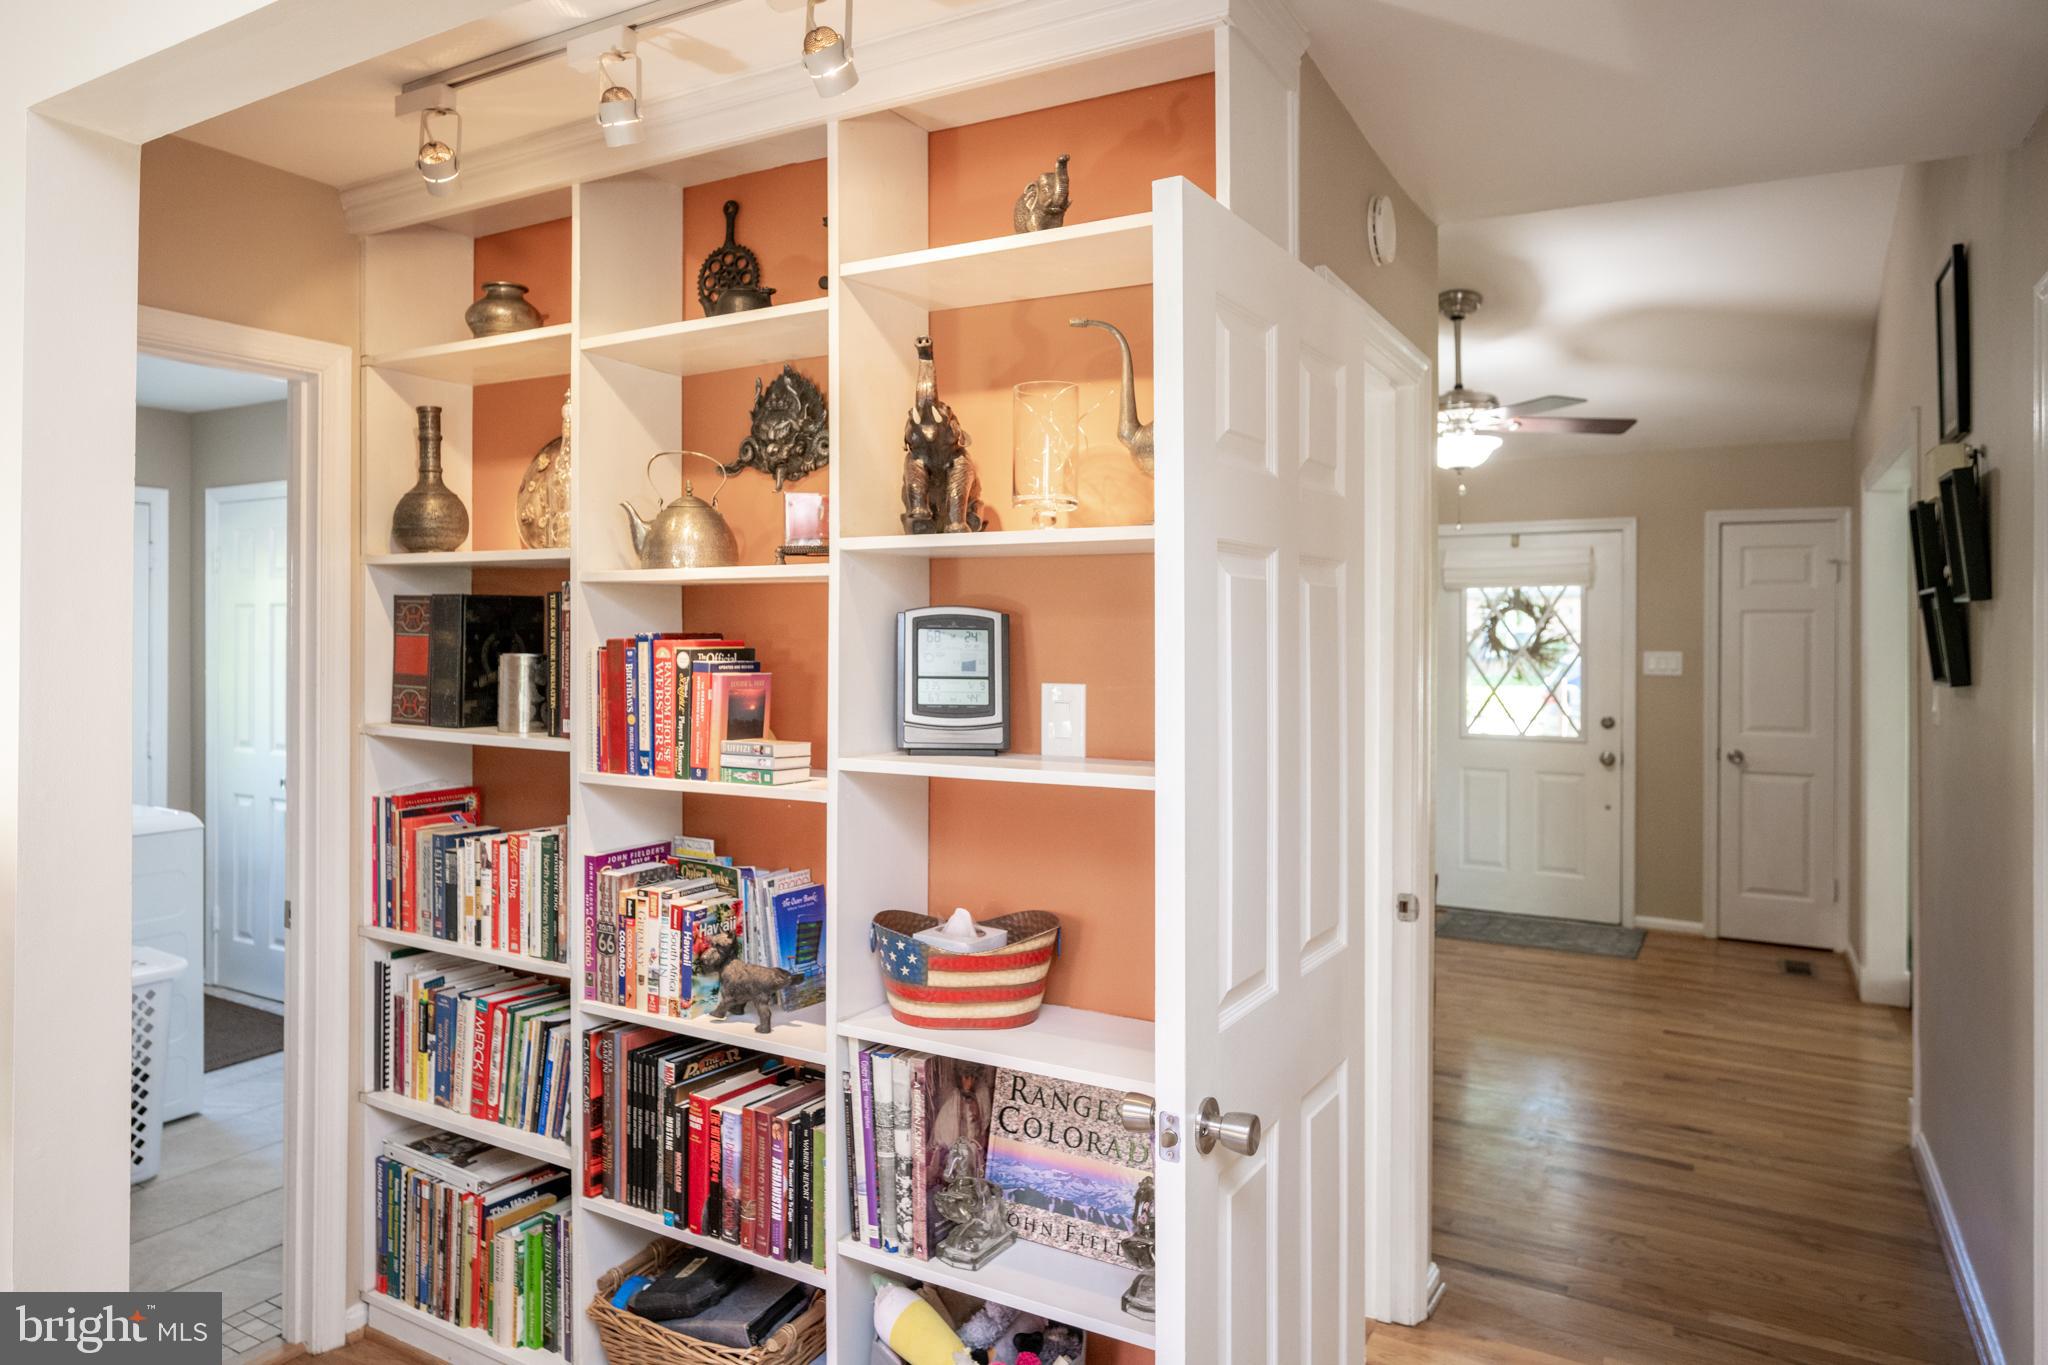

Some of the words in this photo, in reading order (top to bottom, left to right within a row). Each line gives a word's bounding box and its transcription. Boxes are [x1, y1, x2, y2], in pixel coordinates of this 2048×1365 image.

[550, 628, 556, 638] OF
[625, 664, 634, 713] BIRTHDAYS
[664, 662, 672, 719] RANDOM
[655, 661, 664, 761] WEBSTER'S
[664, 720, 672, 762] HOUSE
[678, 716, 686, 740] Players
[676, 741, 686, 776] Dictionary
[607, 852, 628, 864] JOHN
[630, 846, 665, 858] FIELDER'S
[630, 858, 643, 866] BEST
[434, 858, 442, 888] LYLE
[508, 878, 518, 899] Dog
[542, 925, 550, 957] Wildlife
[584, 916, 595, 968] Colorado
[598, 934, 615, 954] 66
[618, 930, 626, 978] COLORADO
[636, 910, 646, 968] GERMANY
[670, 930, 679, 962] South
[682, 930, 692, 966] Hawaii
[659, 932, 669, 978] BERLIN
[669, 964, 678, 992] Africa
[472, 1016, 486, 1073] MERCK
[665, 1115, 674, 1150] MUSTANG
[710, 1112, 720, 1126] THE
[710, 1125, 720, 1140] HOT
[913, 1081, 922, 1158] AFGHANISTAN
[606, 1144, 614, 1169] WORLD
[674, 1151, 682, 1174] MUSCLE
[710, 1140, 720, 1164] HOUSE
[802, 1138, 810, 1170] WARREN
[376, 1162, 384, 1191] HOME
[674, 1175, 682, 1194] CARS
[758, 1170, 765, 1184] TO
[772, 1156, 782, 1221] AFGHANISTAN
[802, 1172, 810, 1202] REPORT
[376, 1191, 384, 1219] BOOK
[1006, 1212, 1053, 1237] OHN
[544, 1222, 554, 1280] WESTERN
[544, 1279, 553, 1328] GARDEN
